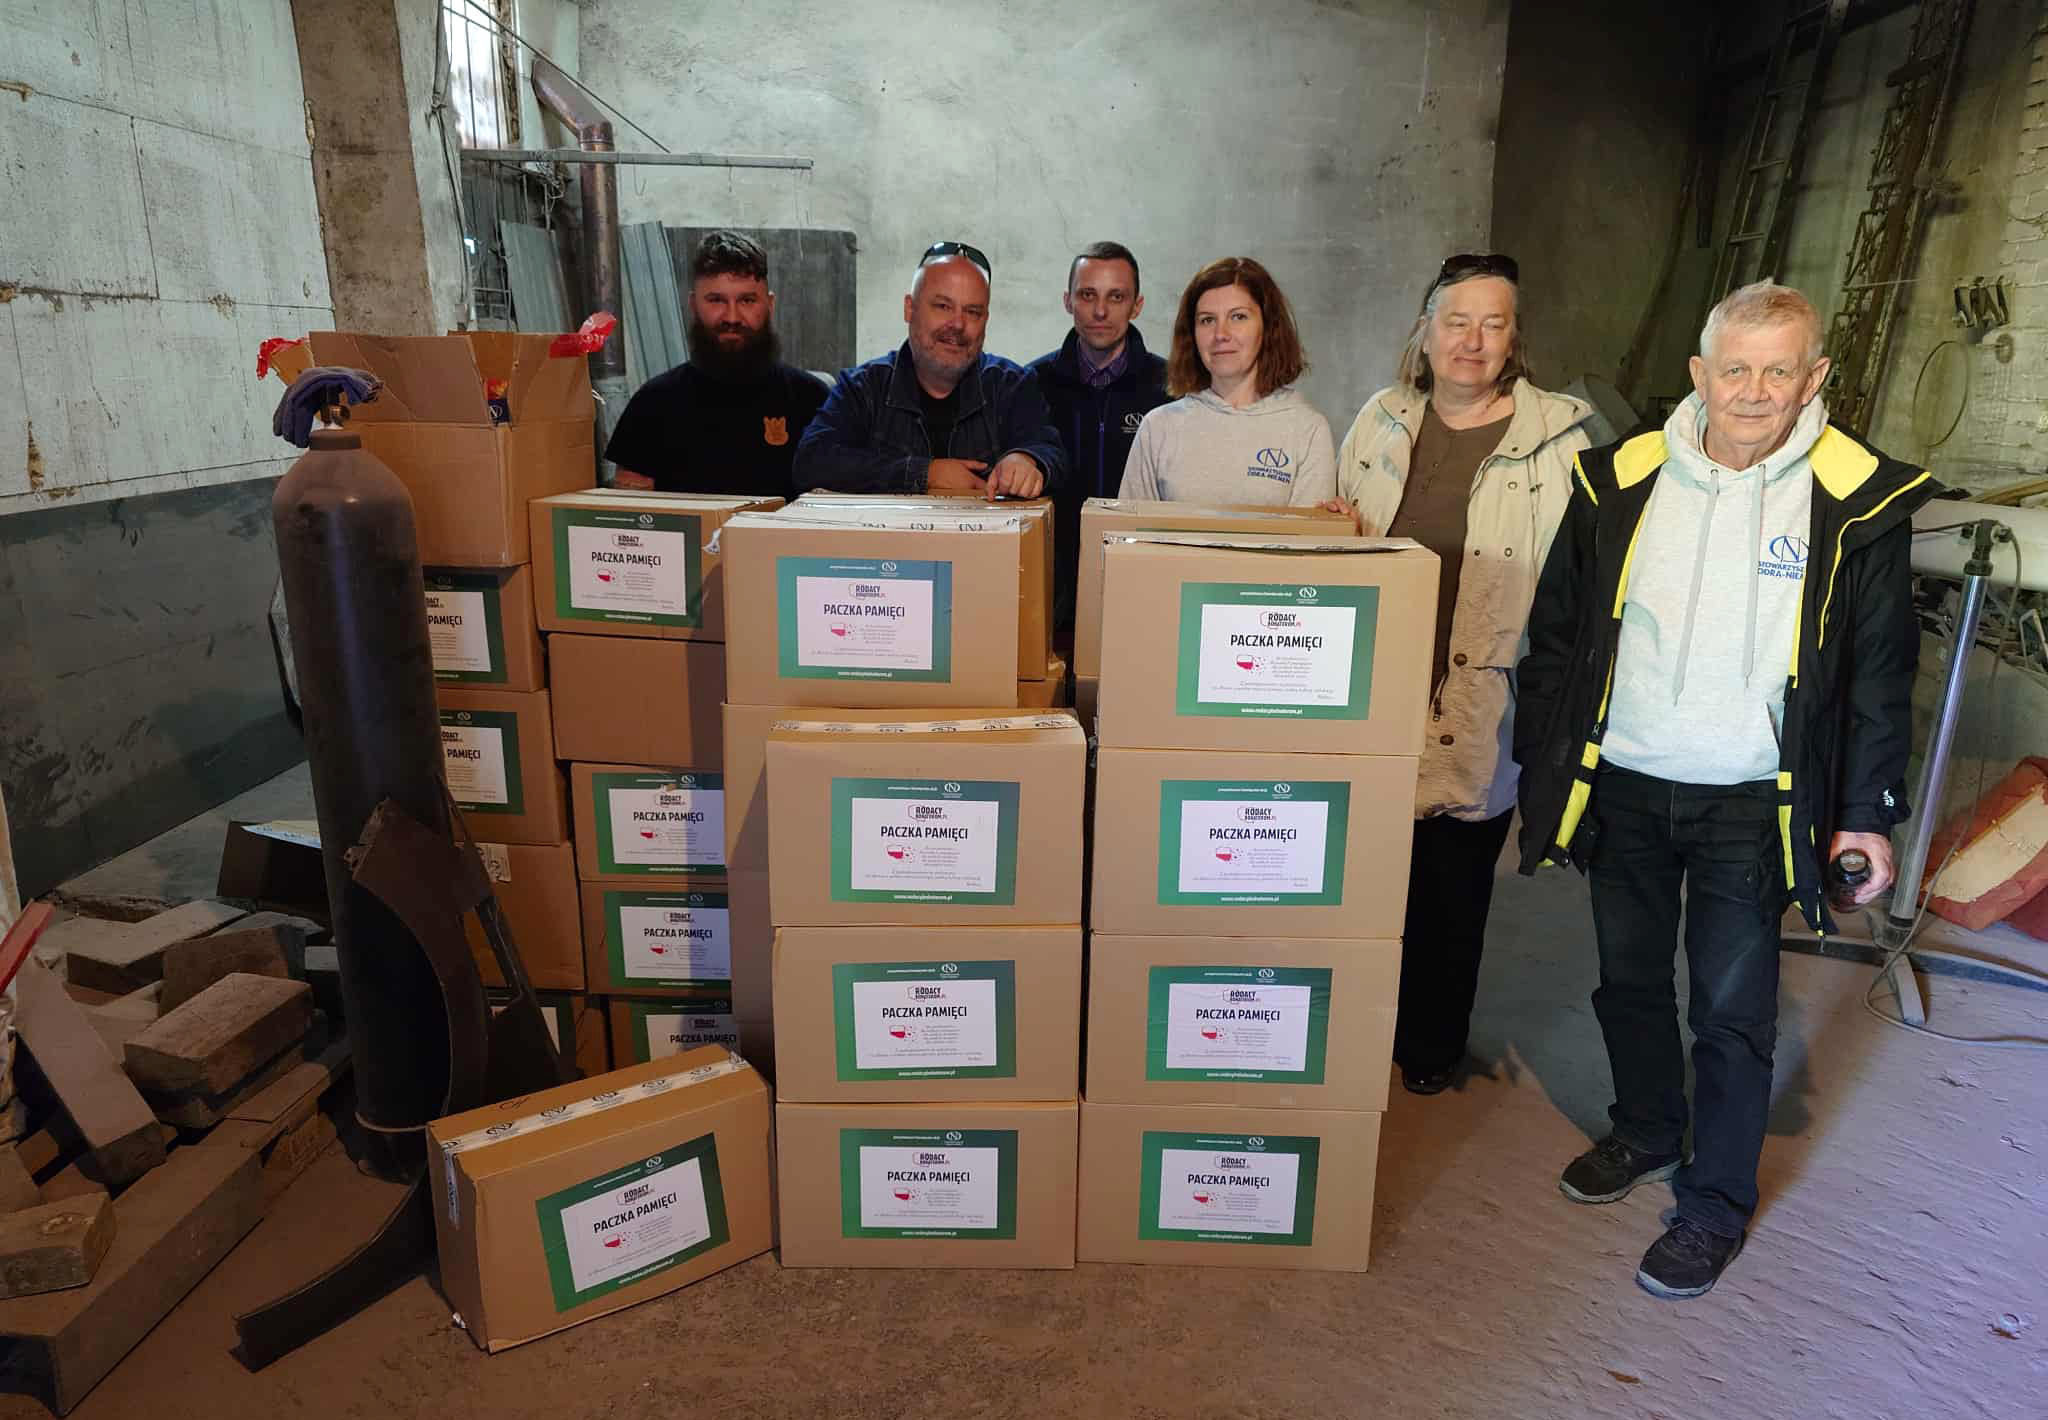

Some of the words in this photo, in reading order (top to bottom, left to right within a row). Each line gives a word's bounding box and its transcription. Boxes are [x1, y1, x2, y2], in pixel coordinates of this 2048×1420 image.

[592, 552, 624, 564] PACZKA
[626, 554, 661, 568] PAMIĘCI
[824, 604, 862, 616] PACZKA
[865, 606, 904, 620] PAMIĘCI
[427, 615, 463, 628] PAMIĘCI
[1231, 635, 1274, 647] PACZKA
[1277, 635, 1323, 651] PAMIĘCI
[447, 748, 481, 761] PAMIĘCI
[634, 812, 666, 821] PACZKA
[669, 812, 704, 824] PAMIĘCI
[881, 826, 921, 838] PACZKA
[925, 827, 968, 842] PAMIĘCI
[1209, 828, 1250, 840] PACZKA
[1254, 828, 1297, 843] PAMIĘCI
[644, 928, 676, 937] PACZKA
[678, 928, 712, 940] PAMIĘCI
[883, 1007, 922, 1018] PACZKA
[925, 1006, 967, 1019] PAMIĘCI
[1196, 1009, 1235, 1020] PACZKA
[1238, 1009, 1280, 1023] PAMIĘCI
[888, 1171, 926, 1182] PACZKA
[930, 1171, 970, 1184] PAMIĘCI
[1188, 1174, 1226, 1185] PACZKA
[1230, 1175, 1269, 1189] PAMIĘCI
[593, 1210, 635, 1233] PACZKA
[636, 1191, 678, 1218] PAMIĘCI
